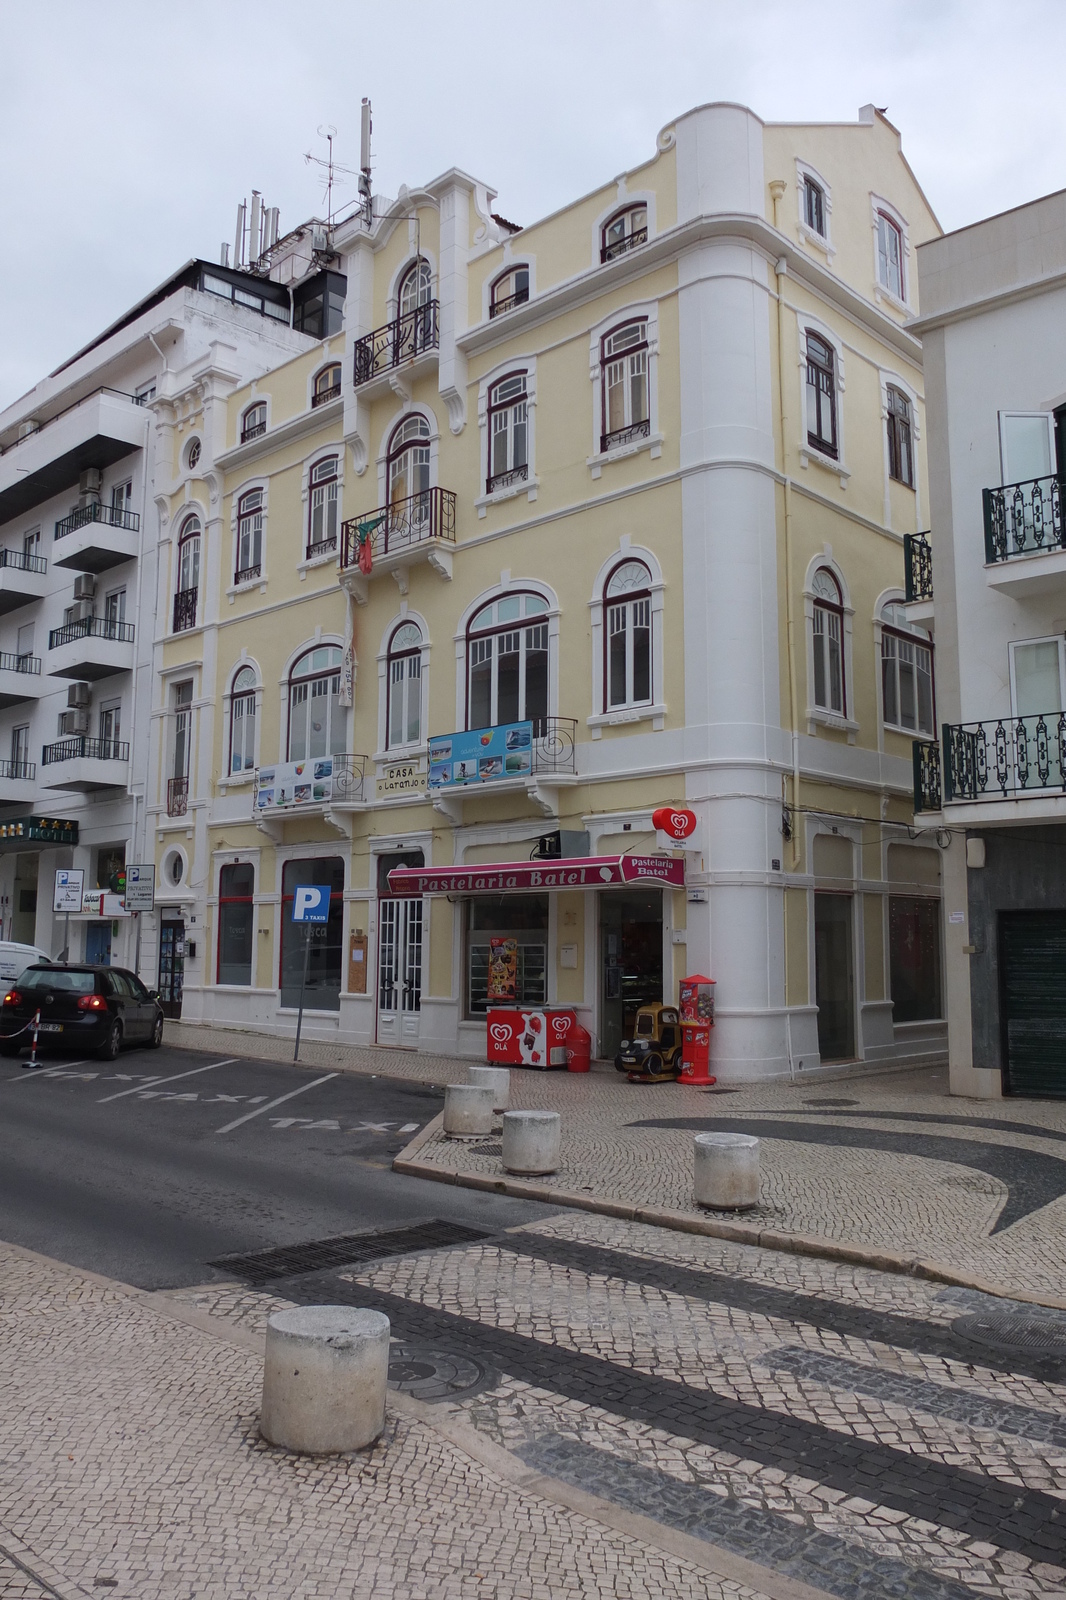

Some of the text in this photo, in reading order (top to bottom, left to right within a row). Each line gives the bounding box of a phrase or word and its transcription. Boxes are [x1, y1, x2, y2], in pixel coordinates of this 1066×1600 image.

[389, 767, 414, 779] CASA
[674, 828, 685, 837] OLÁ
[631, 858, 674, 869] Pastelaria
[637, 867, 669, 876] Batel
[418, 869, 587, 891] Pastelaria Batel
[294, 887, 322, 920] P
[494, 1042, 508, 1051] OLÁ
[42, 1071, 162, 1081] TAXI
[137, 1091, 268, 1103] TAXI
[269, 1117, 420, 1132] TAXI
